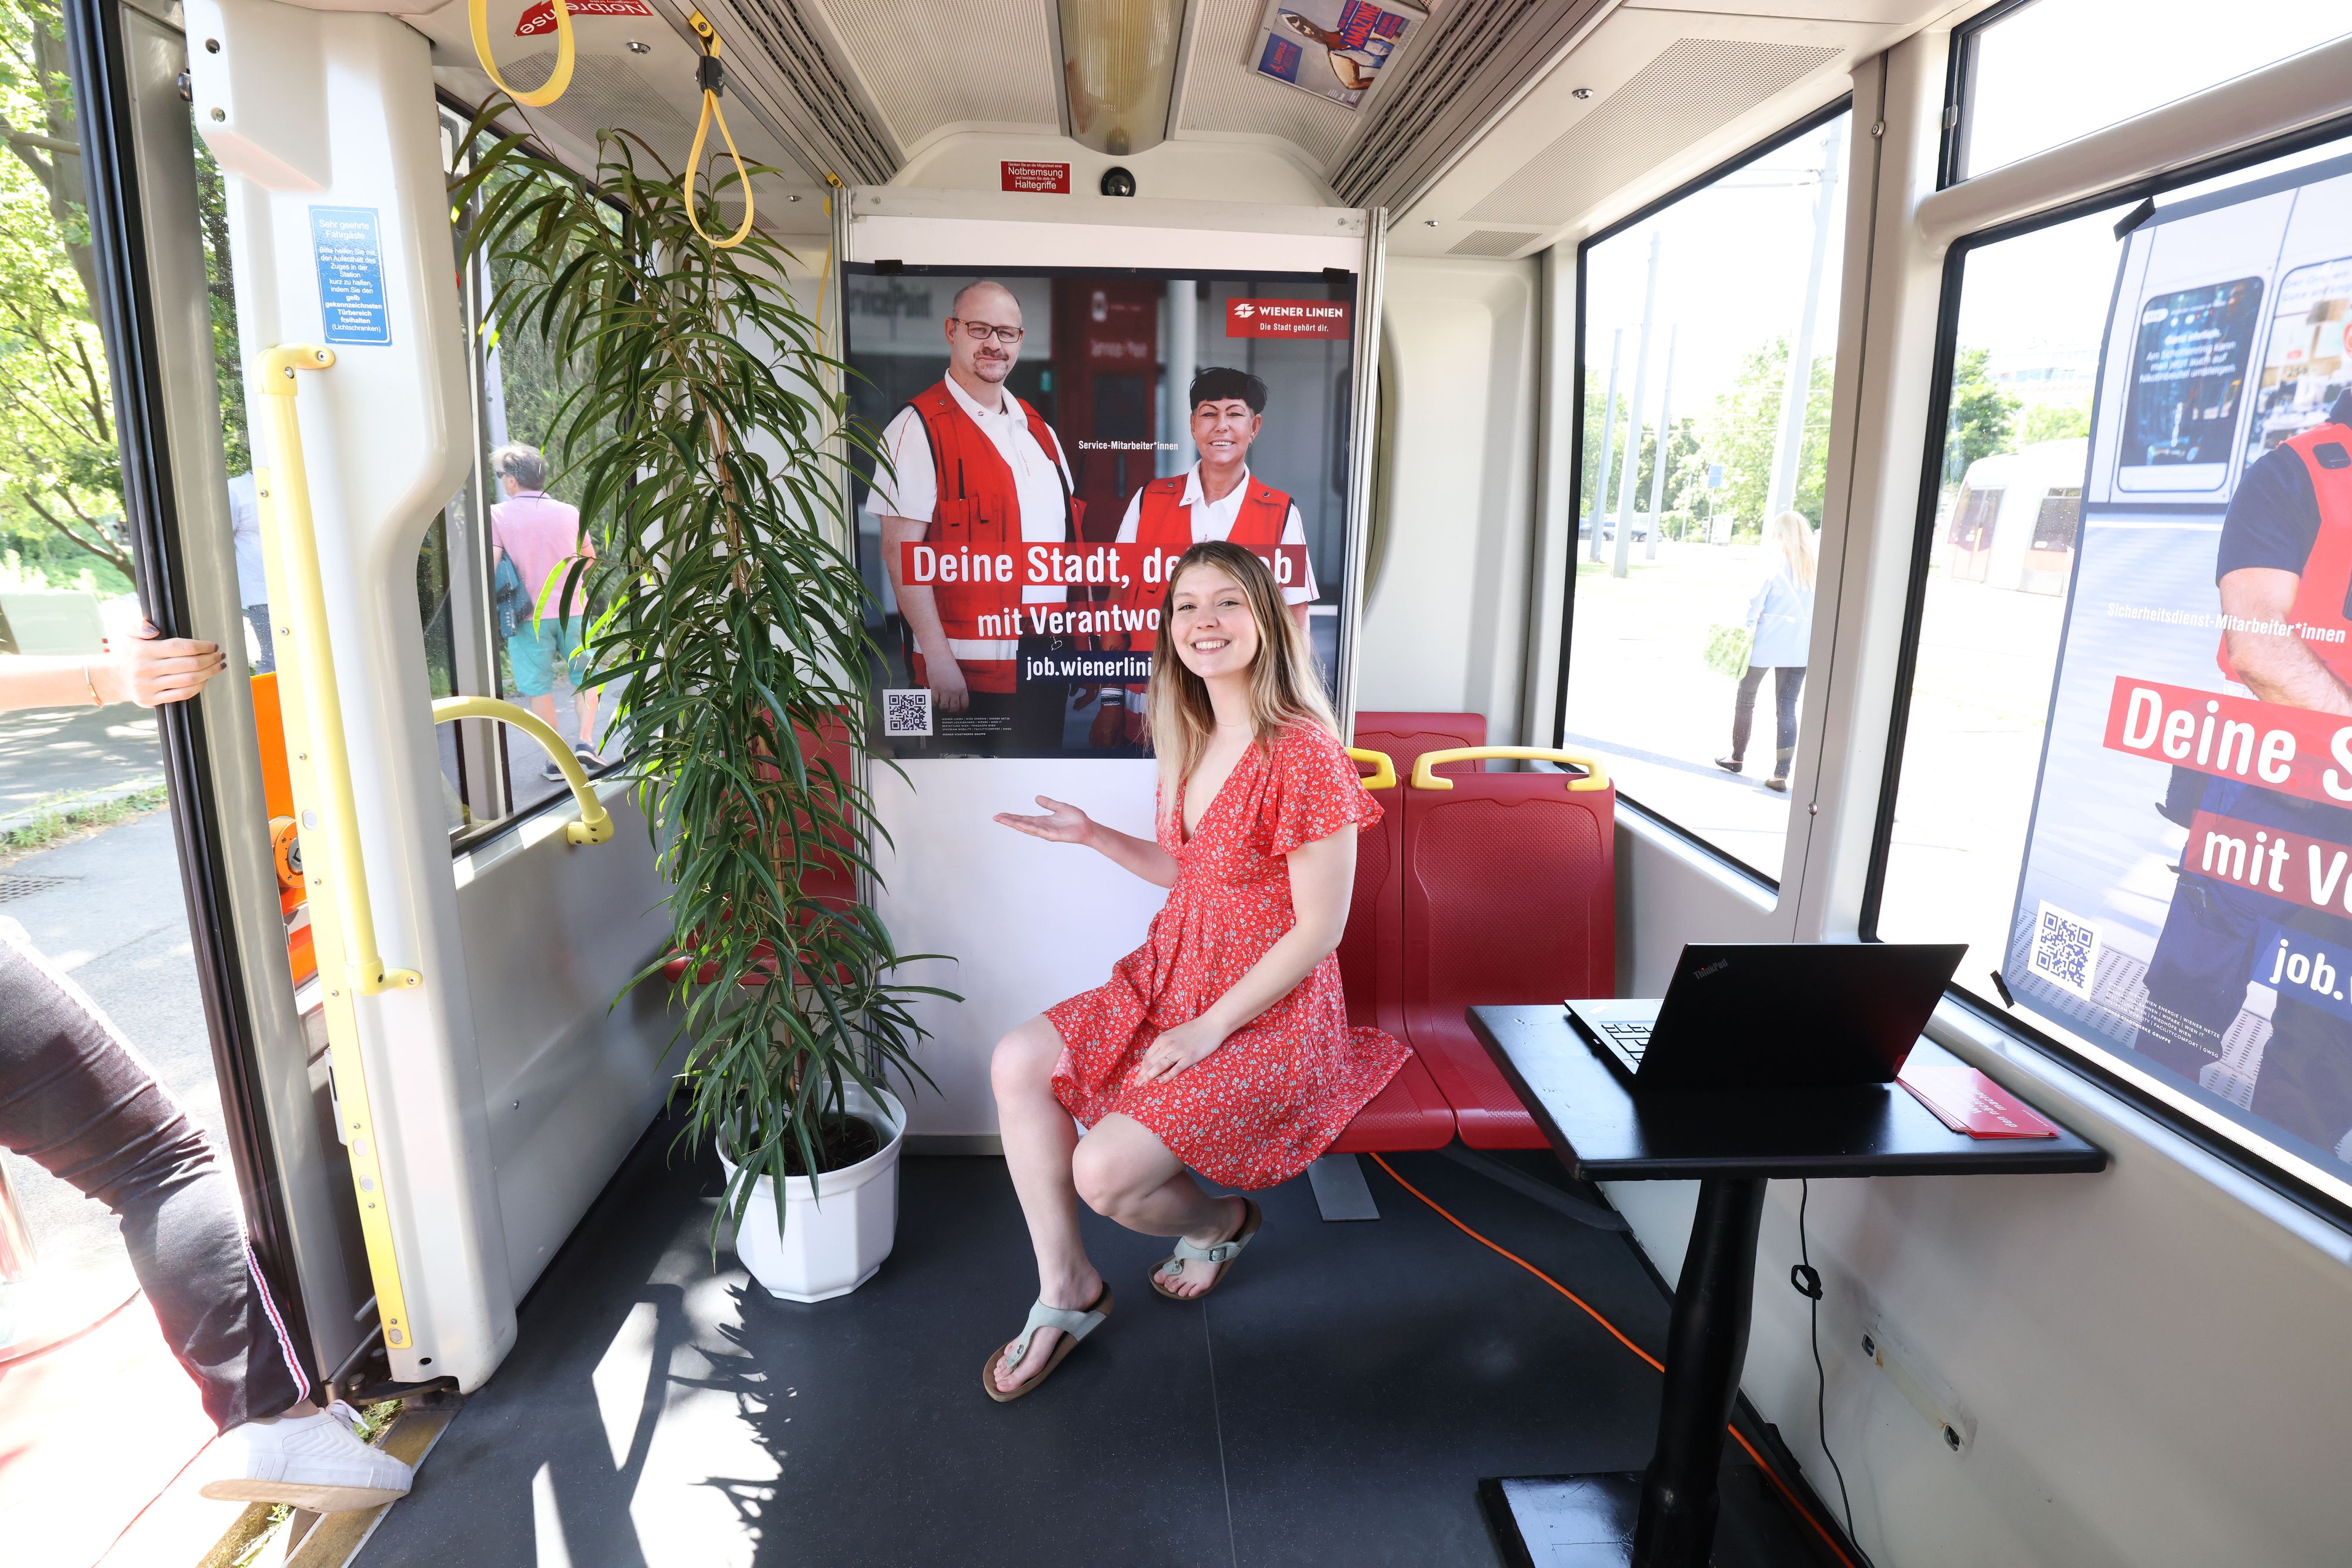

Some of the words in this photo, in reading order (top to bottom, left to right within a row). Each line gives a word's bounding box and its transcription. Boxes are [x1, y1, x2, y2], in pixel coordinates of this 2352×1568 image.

[1344, 1, 1382, 48] AMAZING
[1008, 167, 1063, 178] Notbremsung
[1015, 180, 1056, 190] Haltegriffe
[319, 219, 338, 228] Sehr
[339, 221, 369, 230] geehrte
[326, 230, 365, 240] Fahrgäste
[1259, 306, 1304, 317] WIENER
[1306, 307, 1343, 317] LINIEN
[332, 324, 381, 333] (Lichtschranken)
[1274, 323, 1291, 331] Stadt
[1294, 325, 1315, 333] gehört
[913, 546, 1013, 583] Deine
[1027, 546, 1130, 589] Stadt,
[1143, 547, 1180, 583] de
[978, 606, 1023, 637] mit
[1030, 606, 1160, 636] Verantwo
[1027, 656, 1152, 681] job.wienerlini
[2123, 687, 2296, 784] Deine
[2201, 831, 2290, 892] mit
[2308, 844, 2352, 915] V
[1693, 958, 1728, 979] ThinkPad
[2269, 938, 2352, 1004] job.
[2103, 1006, 2120, 1017] WIENER
[2120, 1015, 2151, 1034] STADTWERKE
[2152, 1031, 2171, 1044] GRUPPE
[2134, 1007, 2147, 1015] WIEN
[2150, 1014, 2177, 1031] FRIEDHÖFE
[2178, 1028, 2191, 1038] WIEN
[2145, 999, 2157, 1008] WIEN
[2158, 1005, 2179, 1018] ENERGIE
[2183, 1017, 2202, 1029] WIENER
[2203, 1027, 2220, 1038] NETZE
[2161, 1014, 2180, 1025] WIPARK
[2184, 1024, 2197, 1034] WIEN
[2128, 1009, 2150, 1023] MOBILITY
[2153, 1022, 2199, 1048] FACILITYCOMFORT
[2203, 1047, 2219, 1058] GWSG
[1996, 1116, 2018, 1127] den
